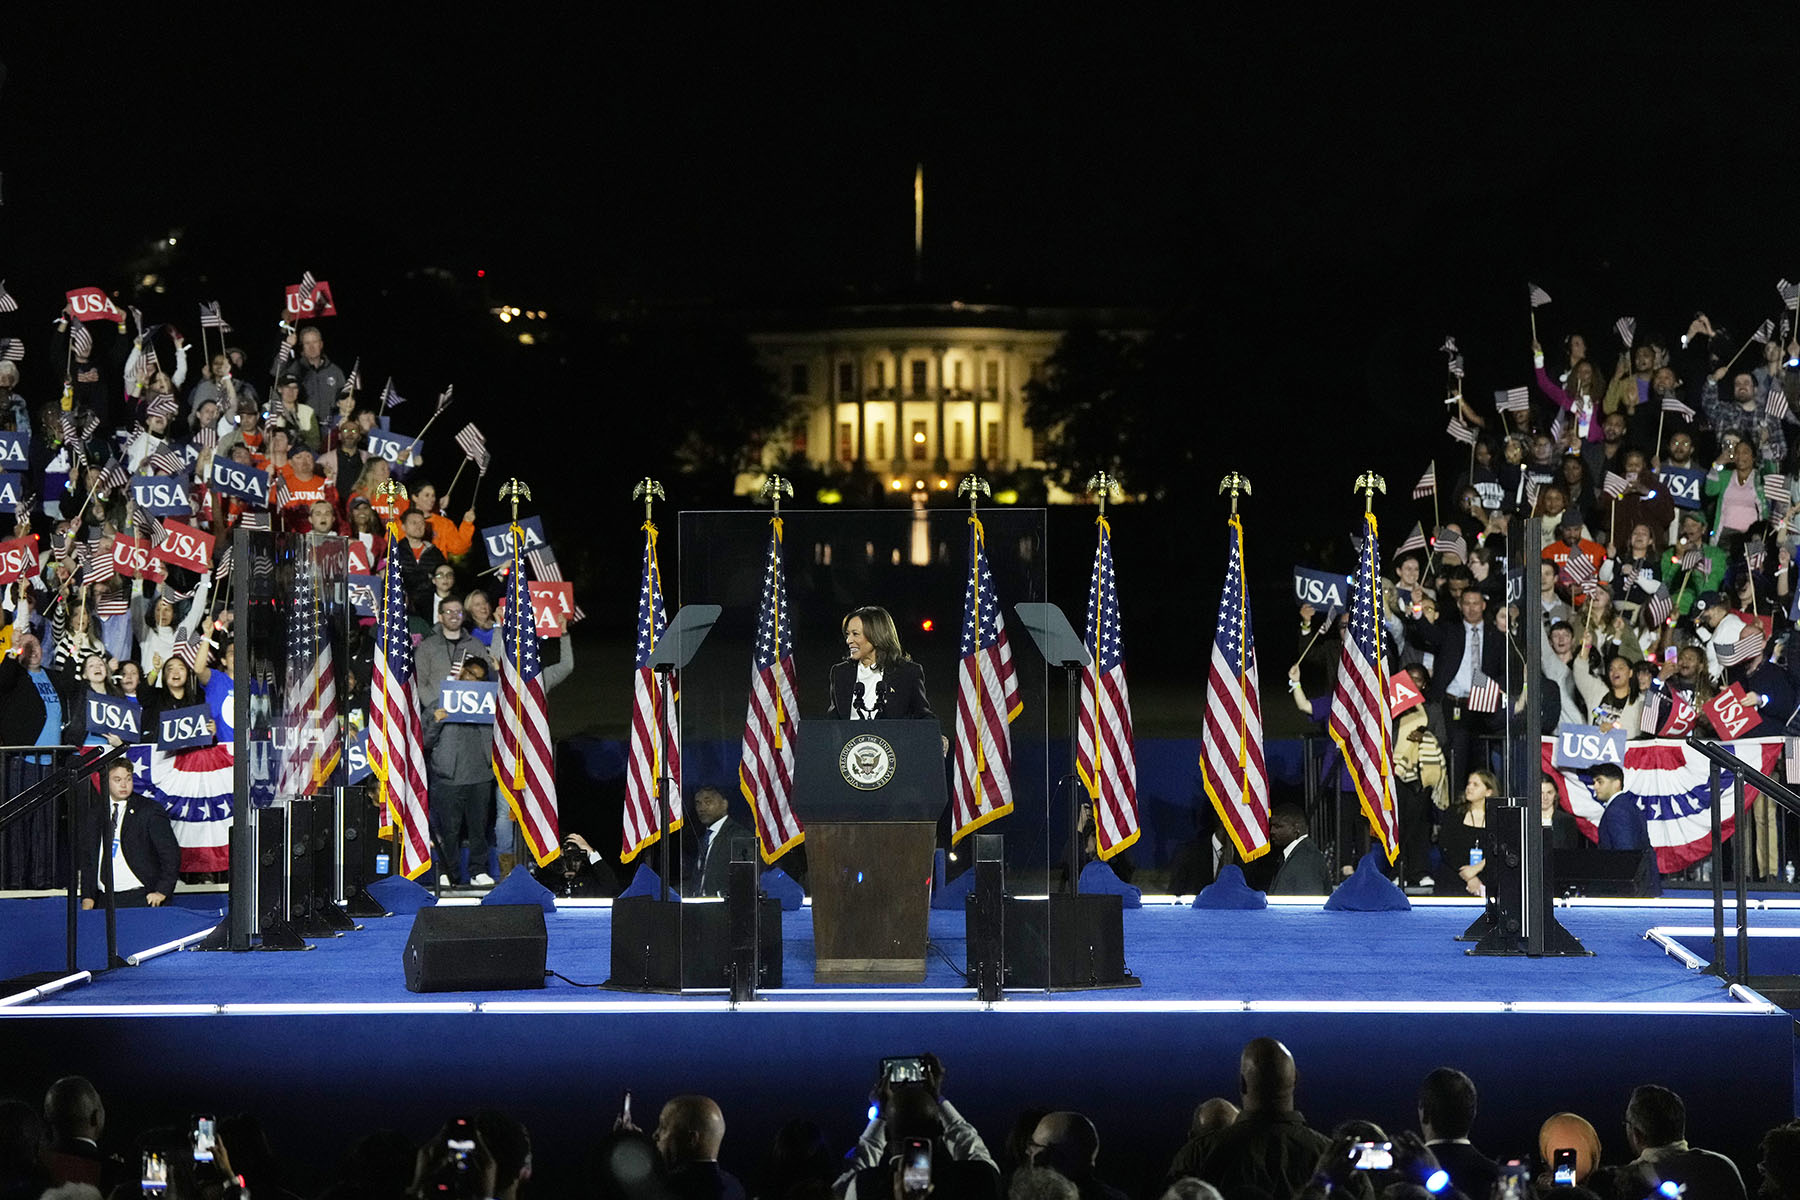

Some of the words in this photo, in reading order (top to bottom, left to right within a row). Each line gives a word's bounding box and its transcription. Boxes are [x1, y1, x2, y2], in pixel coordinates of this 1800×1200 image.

[70, 294, 118, 315] USA
[134, 484, 190, 508] USA
[214, 463, 264, 498] USA
[113, 541, 162, 574] USA
[160, 529, 209, 565] USA
[1295, 575, 1344, 607] USA
[88, 700, 139, 733] USA
[442, 690, 496, 714] USA
[1713, 688, 1750, 738] USA
[161, 714, 211, 743] USA
[1561, 731, 1621, 763] USA
